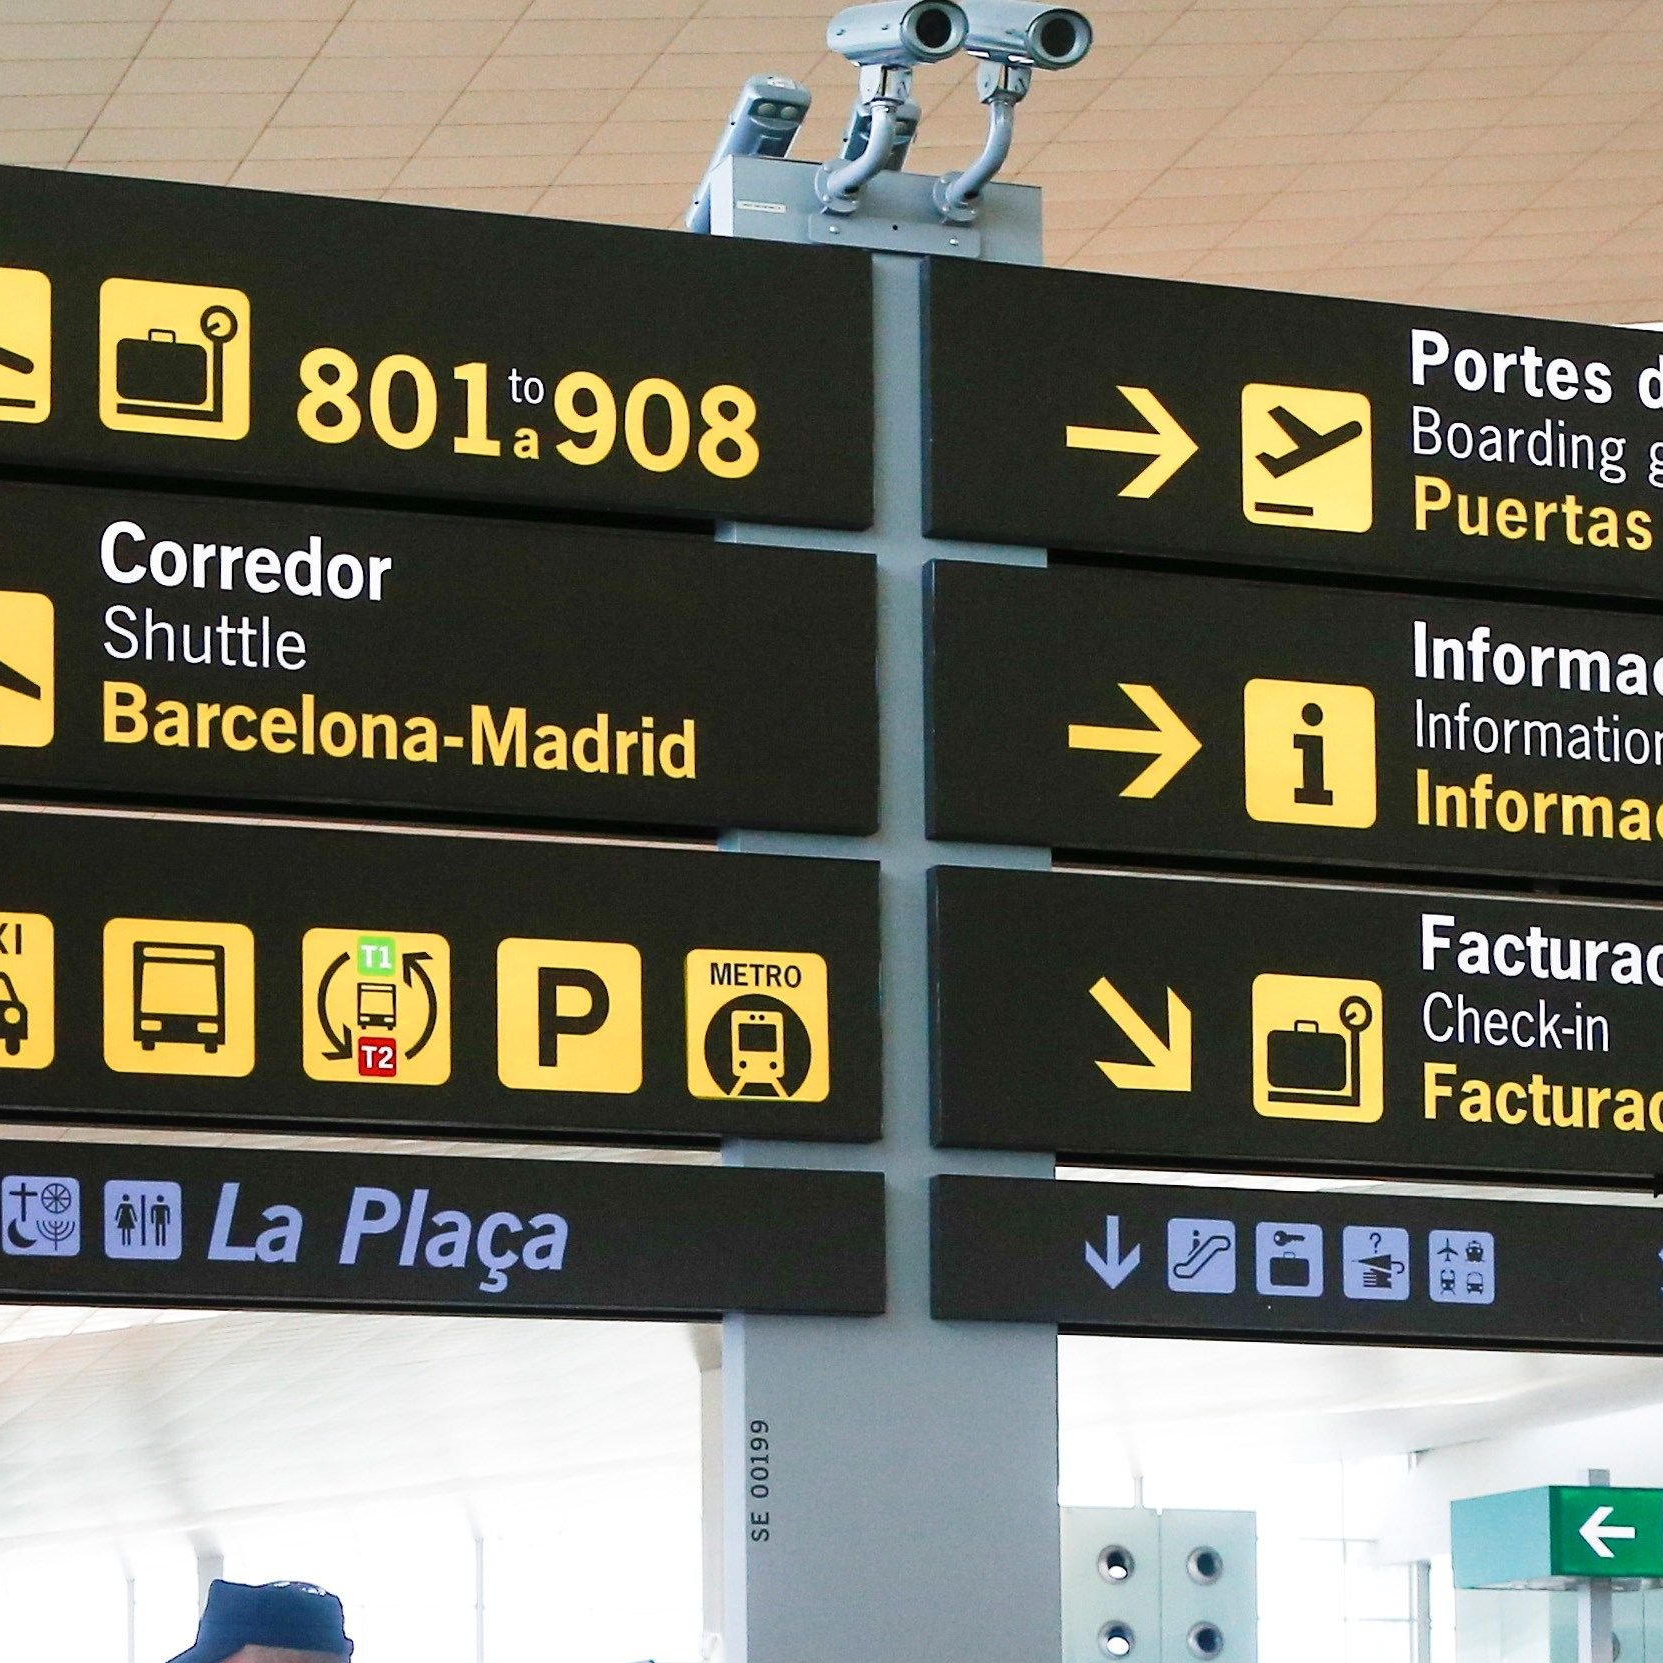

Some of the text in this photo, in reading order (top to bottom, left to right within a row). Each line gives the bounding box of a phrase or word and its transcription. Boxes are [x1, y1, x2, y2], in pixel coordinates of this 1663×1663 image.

[1411, 328, 1612, 404] Portes
[296, 347, 760, 479] 801 to a 908
[1412, 405, 1627, 484] Boarding
[1414, 475, 1653, 551] Puertas
[100, 520, 392, 601] Corredor
[103, 604, 307, 671] Shuttle
[103, 680, 696, 779] Barcelona-Madrid
[361, 942, 393, 971] T1
[710, 962, 802, 989] METRO
[361, 1042, 396, 1073] T2
[1423, 991, 1609, 1052] Check-in
[207, 1182, 569, 1293] La Plaça
[750, 1420, 769, 1542] SE 00199
